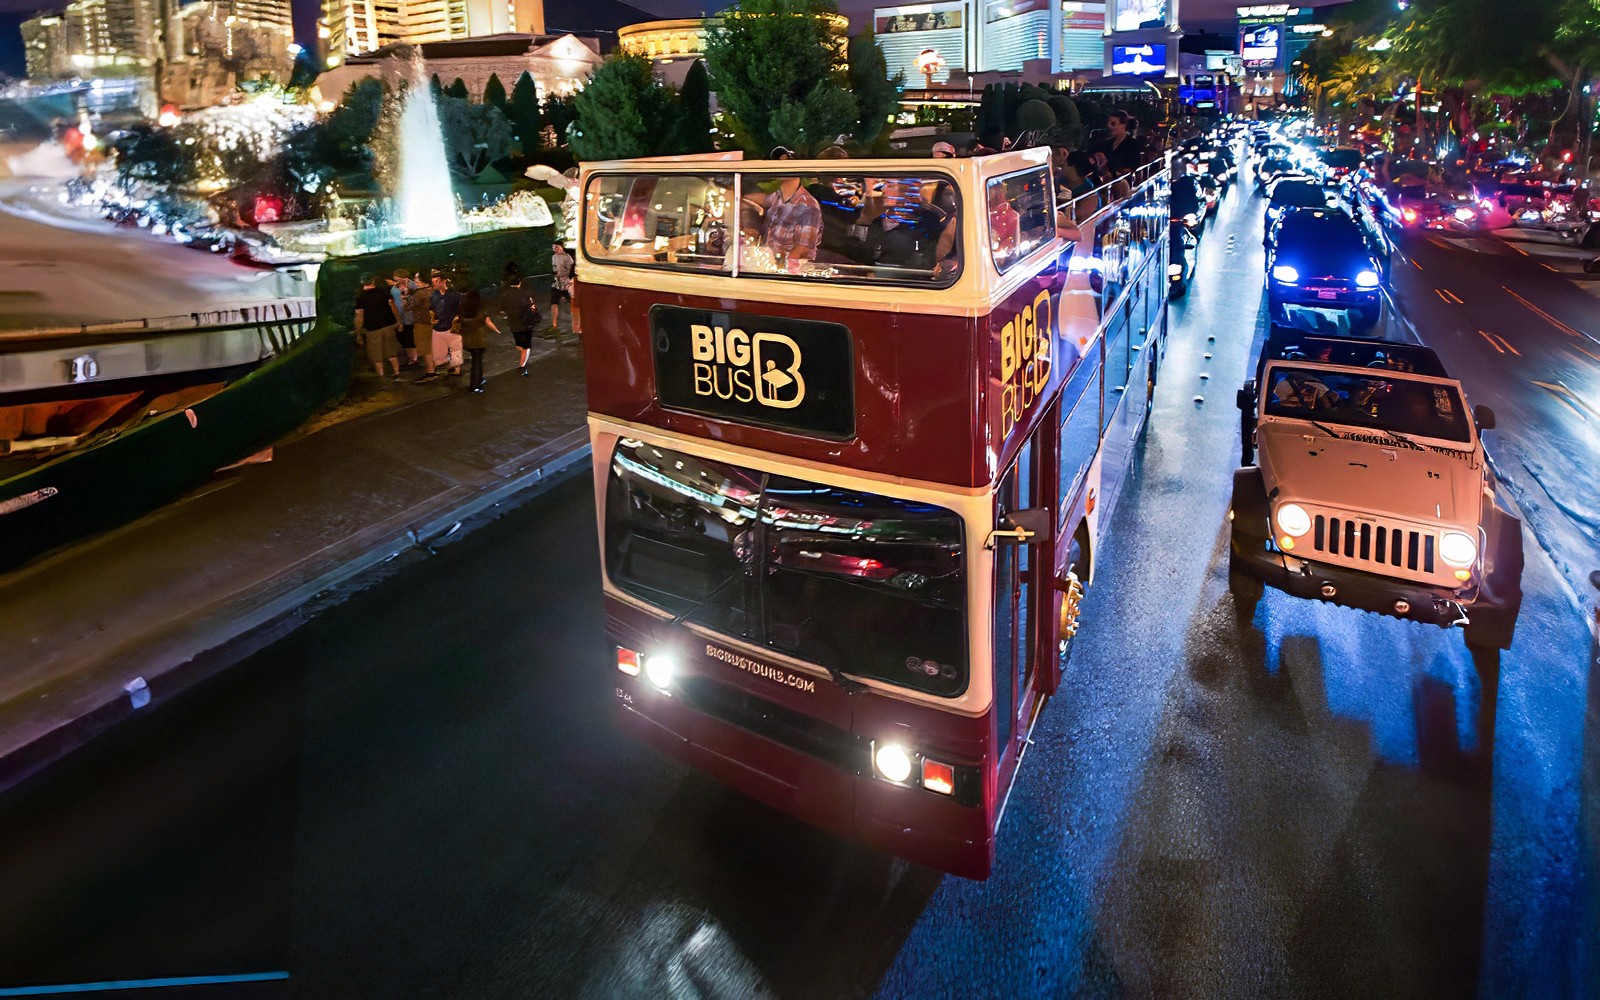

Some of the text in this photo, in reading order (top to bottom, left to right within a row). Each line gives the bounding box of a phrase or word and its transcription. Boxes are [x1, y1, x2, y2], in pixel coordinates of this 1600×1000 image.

[691, 324, 751, 367] BIG
[752, 332, 806, 409] B
[1001, 304, 1033, 385] BIG
[693, 362, 754, 403] BUS
[1002, 360, 1034, 440] BUS
[706, 644, 815, 693] BIGBUSTOURS.COM
